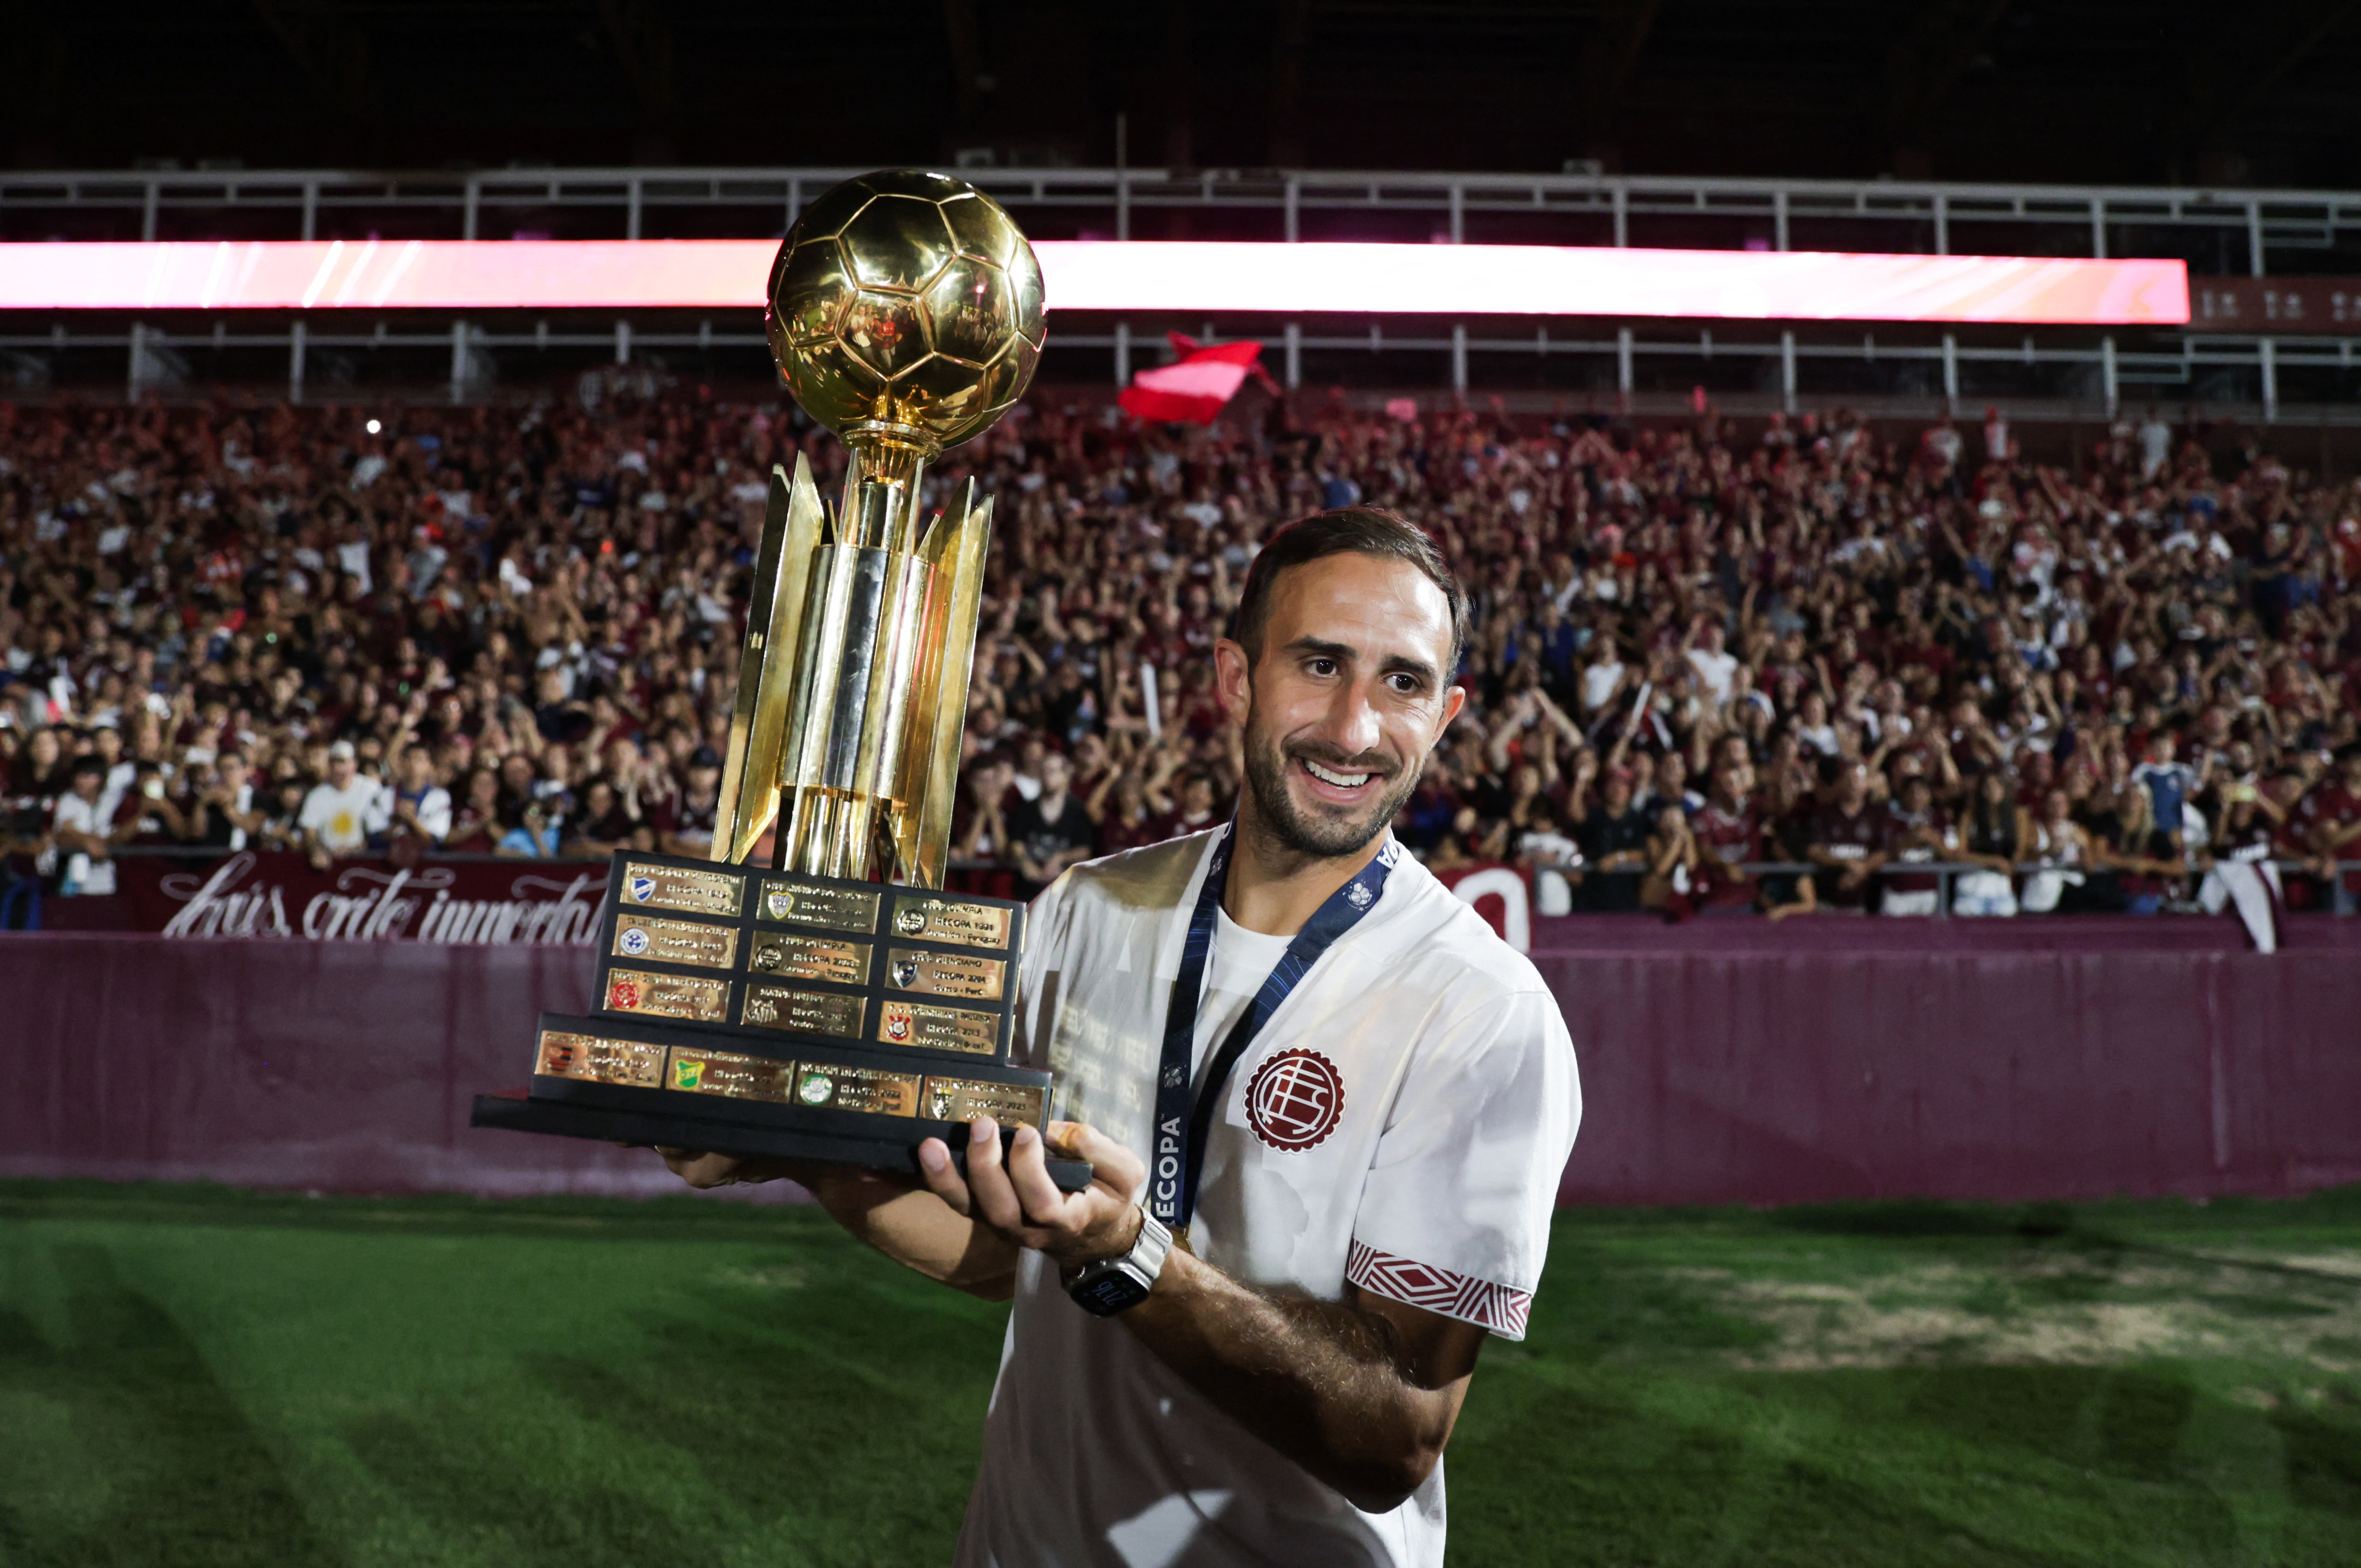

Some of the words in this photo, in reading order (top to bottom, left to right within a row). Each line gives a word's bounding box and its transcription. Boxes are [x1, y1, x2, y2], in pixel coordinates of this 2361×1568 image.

[947, 903, 983, 915] OLIMPIA
[935, 917, 971, 929] RECOPA
[974, 922, 994, 931] 1991
[936, 956, 982, 968] CIENCIANO
[933, 970, 965, 981] RECOPA
[1155, 1116, 1180, 1226] ECOPA
